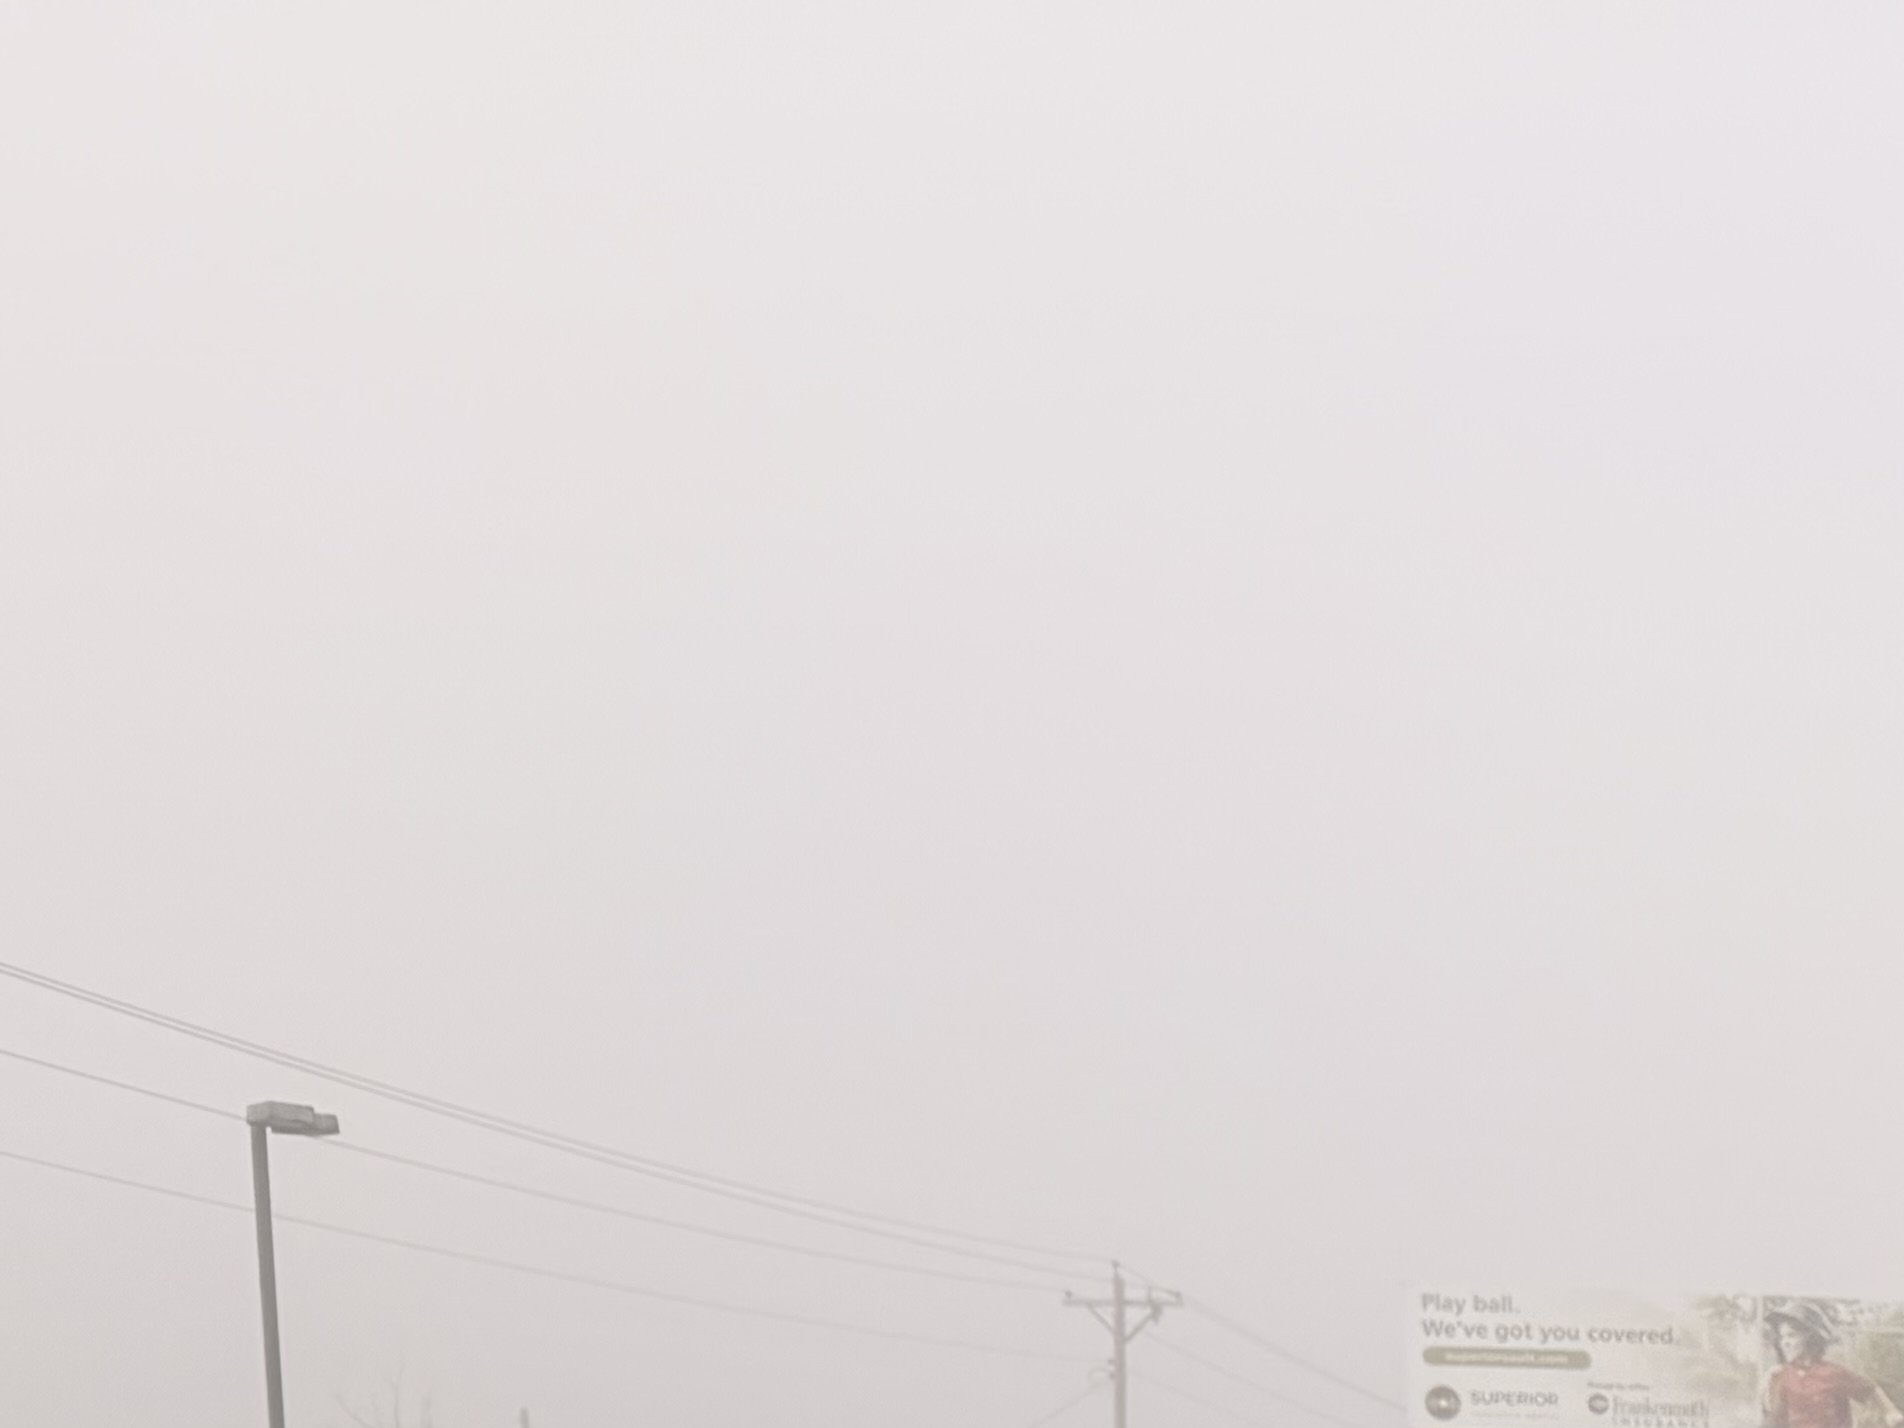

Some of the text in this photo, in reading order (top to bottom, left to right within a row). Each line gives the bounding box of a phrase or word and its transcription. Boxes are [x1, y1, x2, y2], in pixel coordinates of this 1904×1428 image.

[1421, 1293, 1521, 1315] Play ball.
[1422, 1320, 1681, 1346] We've got you covered.
[1470, 1391, 1559, 1408] SUPERIOR
